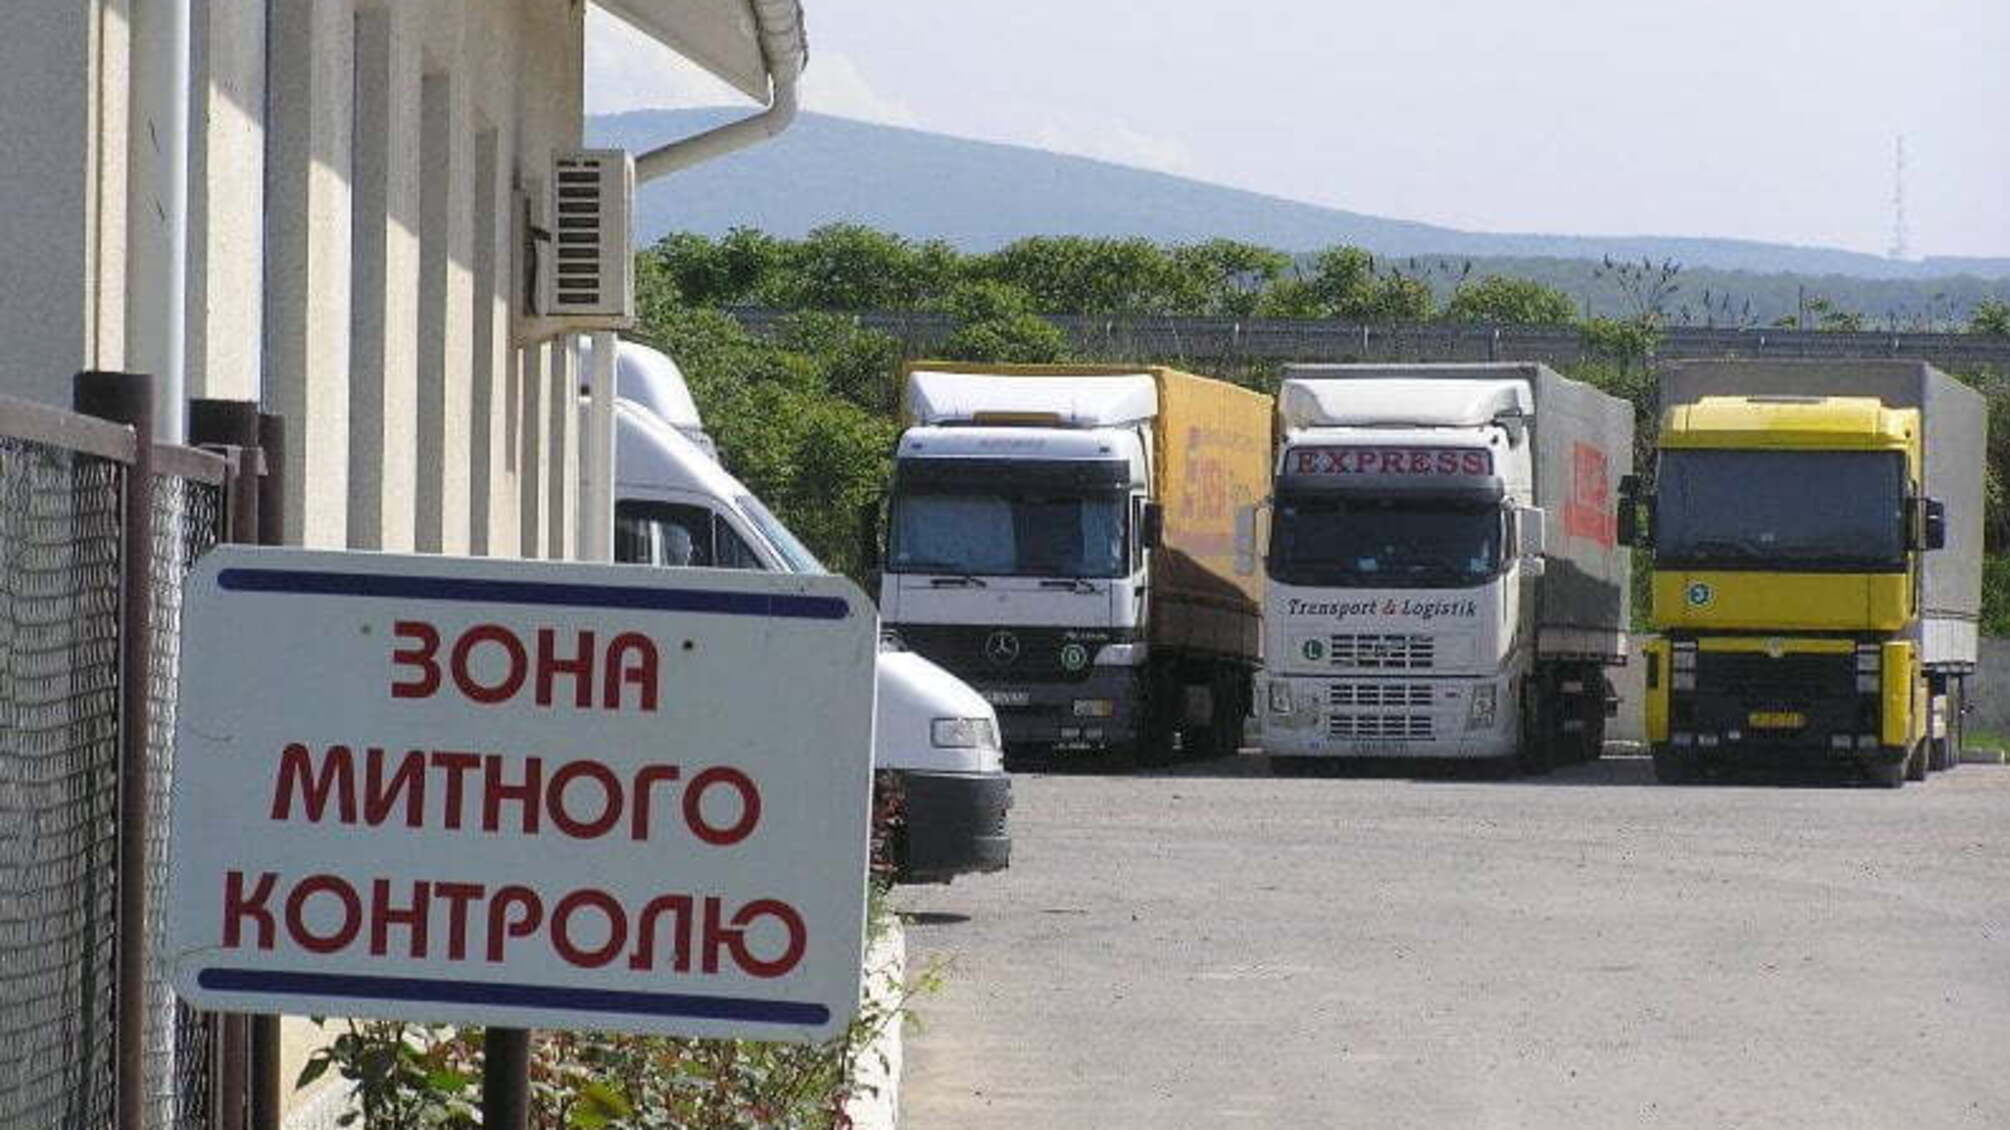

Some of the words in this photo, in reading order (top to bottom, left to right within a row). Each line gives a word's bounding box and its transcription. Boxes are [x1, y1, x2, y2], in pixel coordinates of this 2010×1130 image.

[1298, 452, 1485, 474] EXPRESS
[1289, 599, 1378, 620] Transport
[1382, 600, 1396, 616] &
[1402, 599, 1478, 620] Logistik
[392, 620, 658, 711] ЗОНА
[270, 742, 762, 846] МИТНОГО
[221, 870, 807, 978] КОНТРОЛЮ
